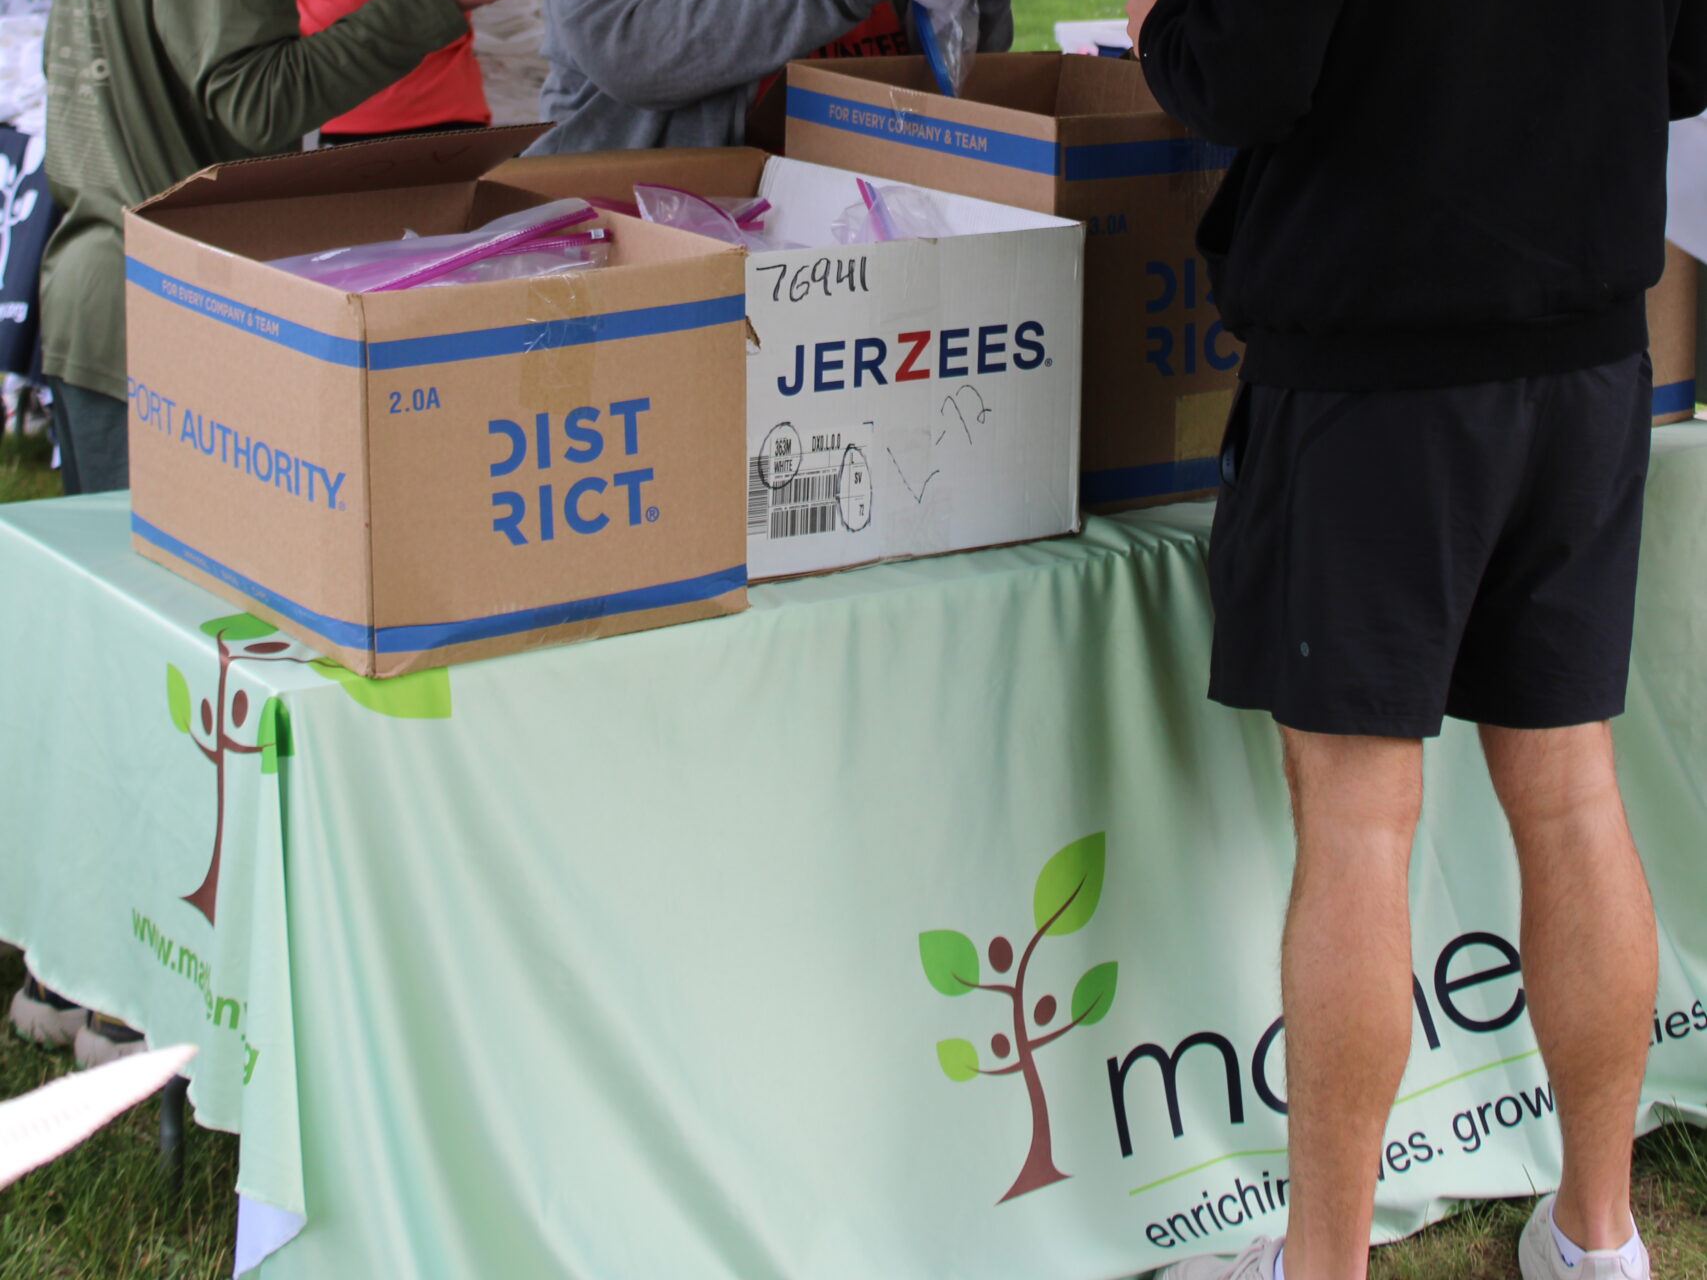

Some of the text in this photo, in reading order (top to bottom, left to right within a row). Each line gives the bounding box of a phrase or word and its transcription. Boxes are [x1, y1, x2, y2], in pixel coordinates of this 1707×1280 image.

[828, 103, 988, 153] FOR EVERY COMPANY & TEAM
[756, 255, 870, 303] 76941
[204, 296, 246, 325] COMPANY
[254, 314, 280, 337] TEAM
[1145, 319, 1241, 377] RIC
[388, 386, 441, 415] 2.0A
[488, 397, 651, 478] DIST
[773, 459, 793, 474] WHITE
